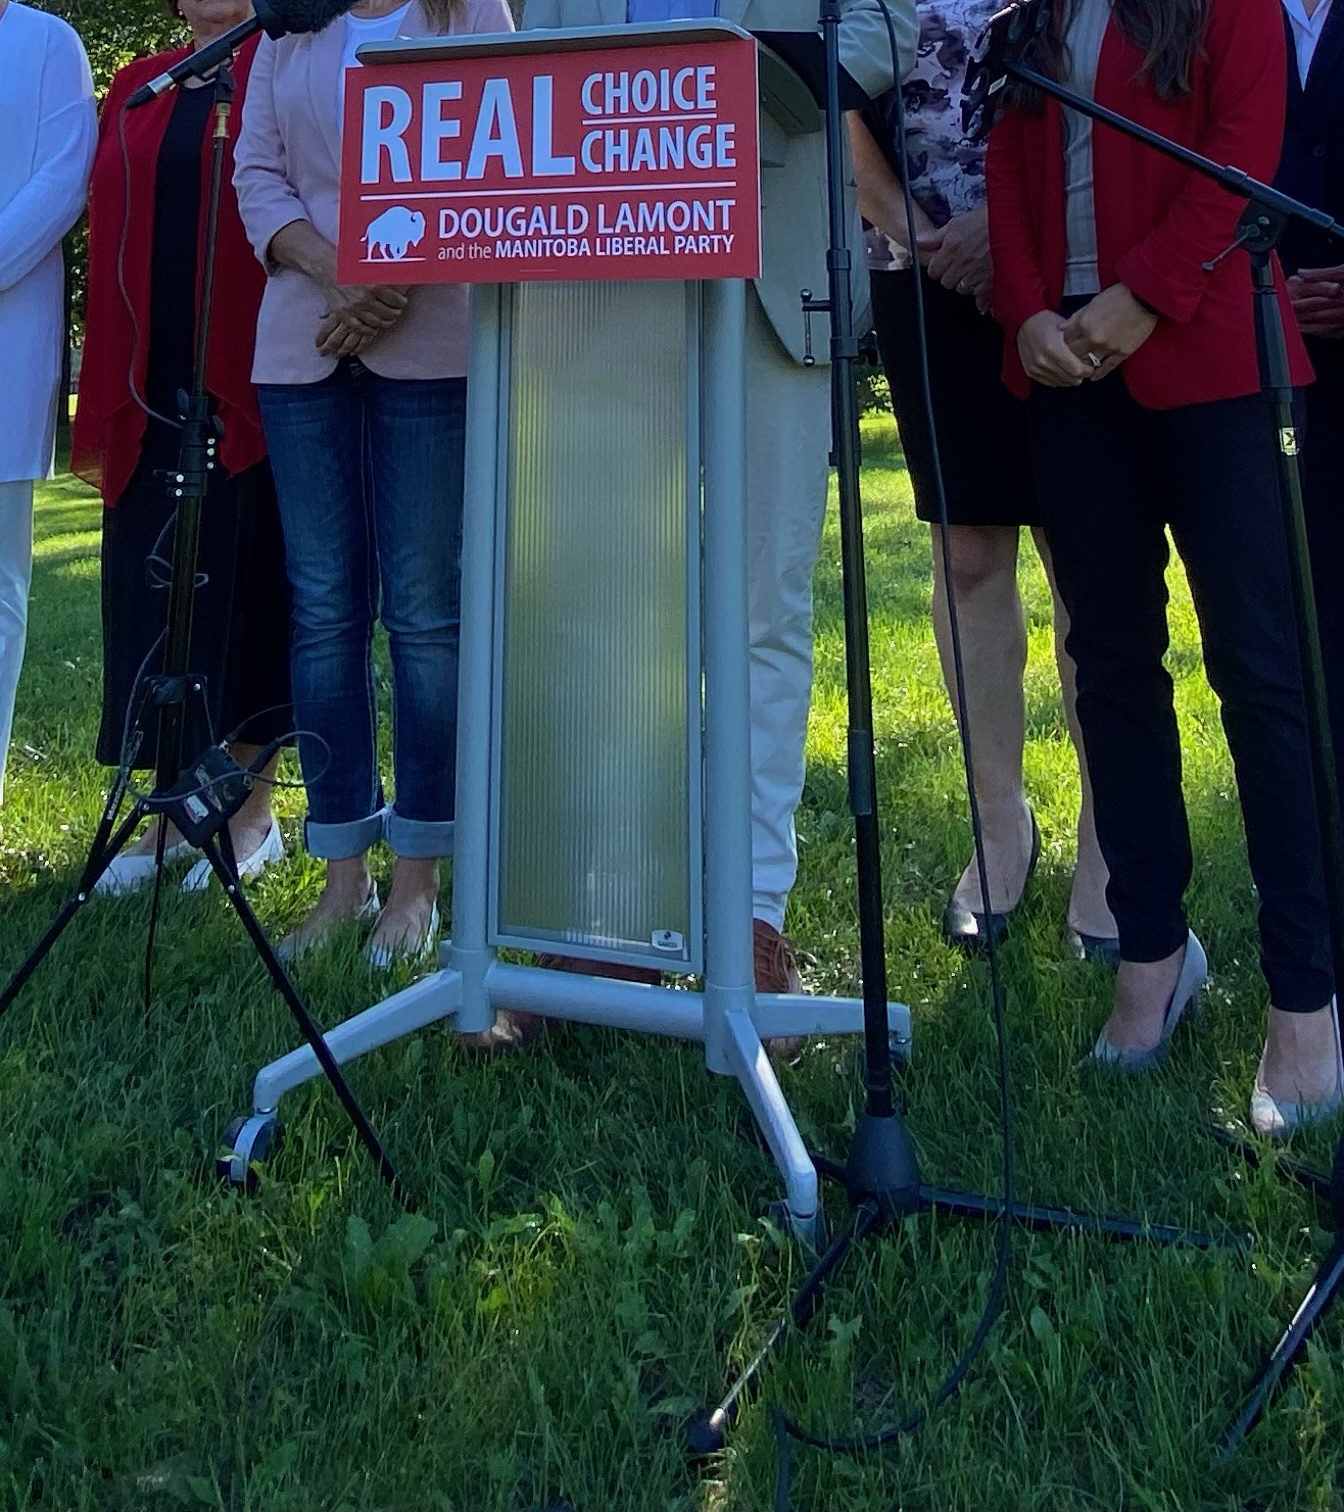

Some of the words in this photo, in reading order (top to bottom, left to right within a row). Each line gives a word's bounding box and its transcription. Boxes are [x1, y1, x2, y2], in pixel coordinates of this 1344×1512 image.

[581, 65, 717, 115] CHOICE
[361, 75, 576, 184] REAL
[581, 124, 736, 173] CHANGE
[438, 205, 589, 239] DOUGALD
[598, 199, 736, 233] LAMONT
[437, 244, 465, 260] and
[468, 242, 491, 259] the
[495, 239, 591, 258] MANITOBA
[595, 236, 670, 256] LIBERAL
[673, 234, 734, 255] PARTY
